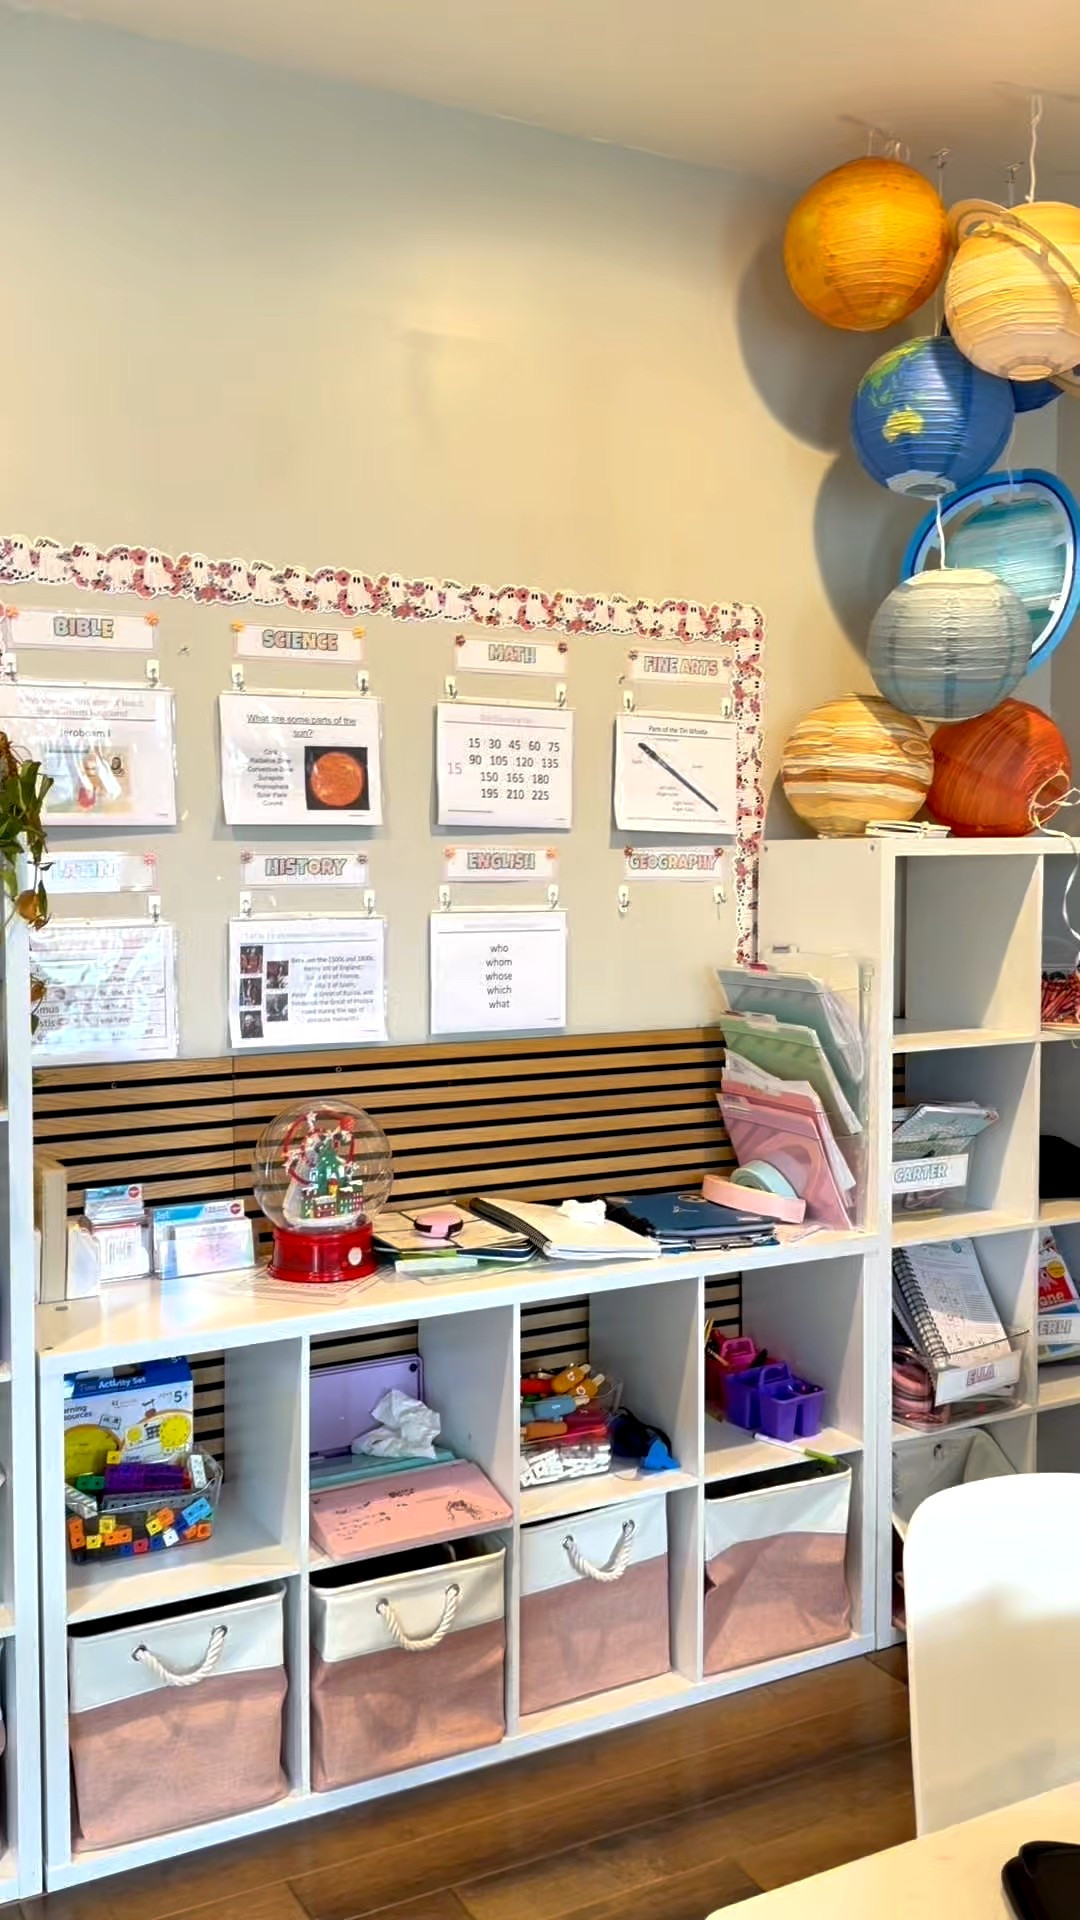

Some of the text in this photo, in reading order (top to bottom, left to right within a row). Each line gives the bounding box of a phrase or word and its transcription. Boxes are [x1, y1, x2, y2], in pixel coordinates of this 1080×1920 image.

[53, 616, 114, 638] BIBLE
[262, 629, 339, 651] SCIENCE
[488, 643, 537, 664] MATH
[643, 655, 719, 676] FINE ARTS
[468, 738, 560, 752] 15 30 45 60 75
[469, 755, 559, 768] 90 105 120 135
[448, 762, 462, 775] 15
[480, 772, 549, 784] 150 165 180
[481, 788, 550, 800] 195 210 225
[264, 857, 349, 877] HISTORY
[467, 852, 536, 870] ENGLISH
[629, 852, 718, 871] GEOGRAPHY
[490, 943, 509, 953] who
[485, 957, 512, 967] whom
[485, 972, 512, 981] whose
[486, 984, 512, 995] which
[489, 999, 510, 1008] what
[894, 1163, 949, 1183] CARTER
[1040, 1291, 1064, 1306] one
[966, 1364, 996, 1387] ELLA
[98, 1378, 130, 1389] Activity
[132, 1376, 146, 1385] Set
[173, 1390, 188, 1403] 5+
